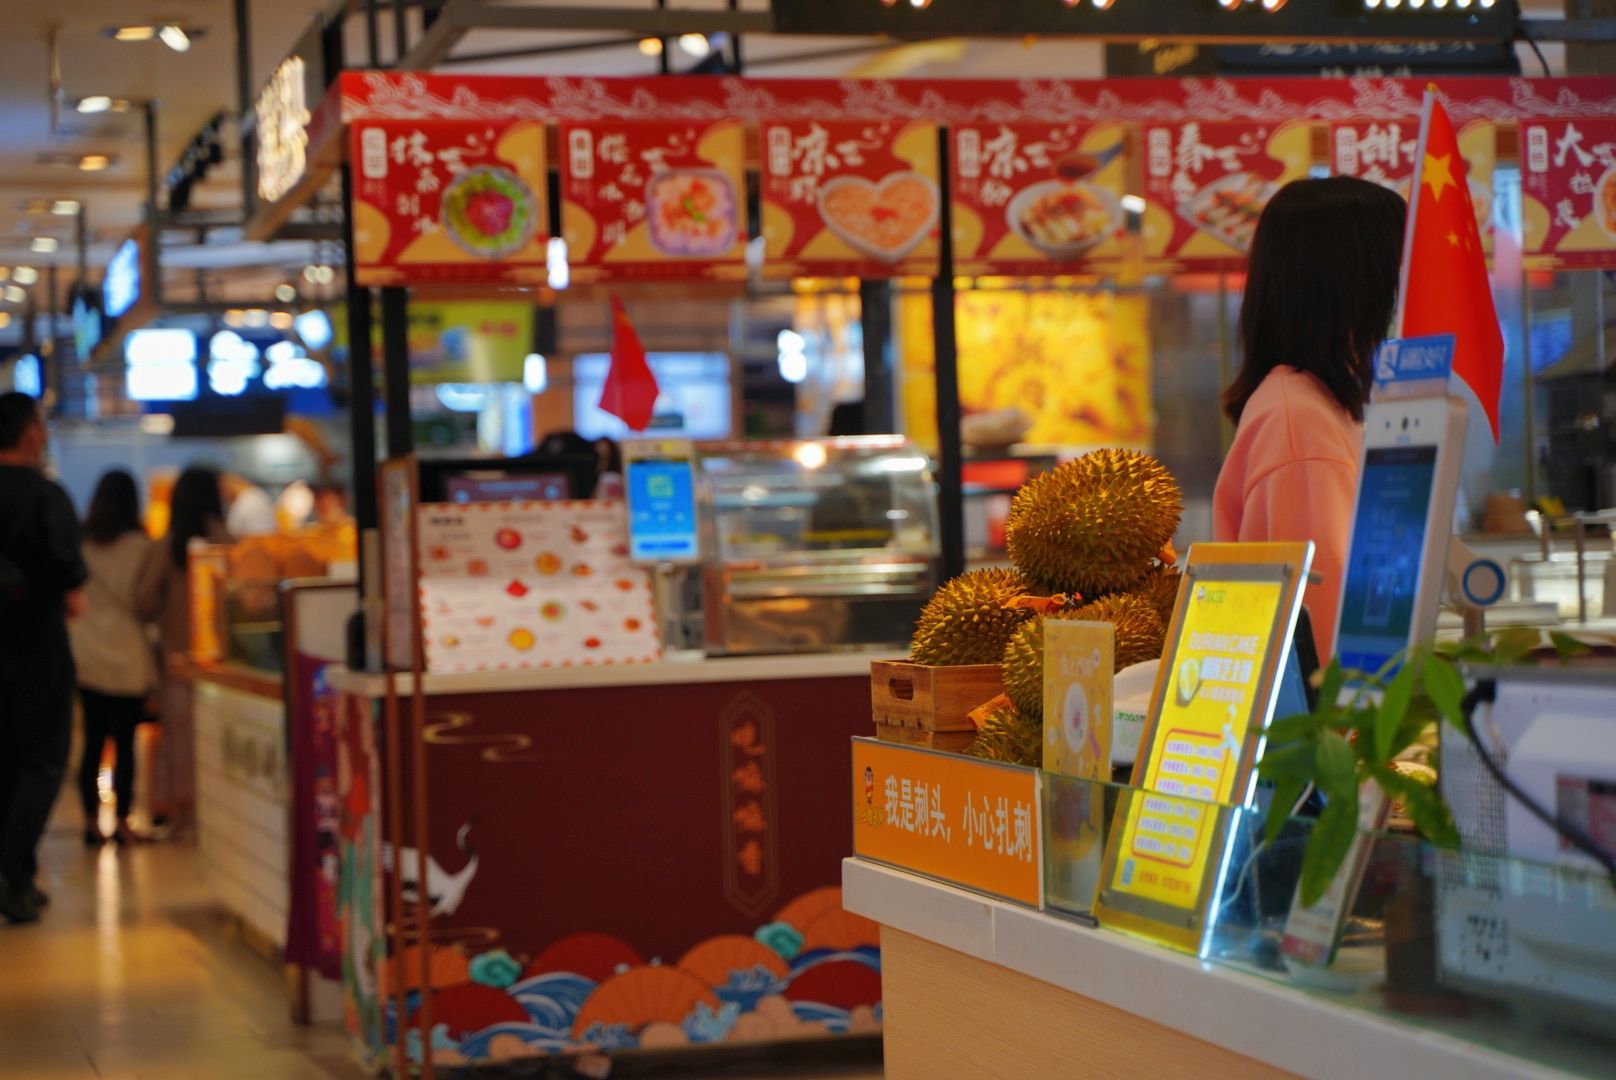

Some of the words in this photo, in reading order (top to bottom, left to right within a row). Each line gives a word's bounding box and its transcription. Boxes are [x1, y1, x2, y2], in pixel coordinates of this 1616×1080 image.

[1230, 634, 1260, 655] CAKE
[962, 790, 1033, 864] 小心扎刺
